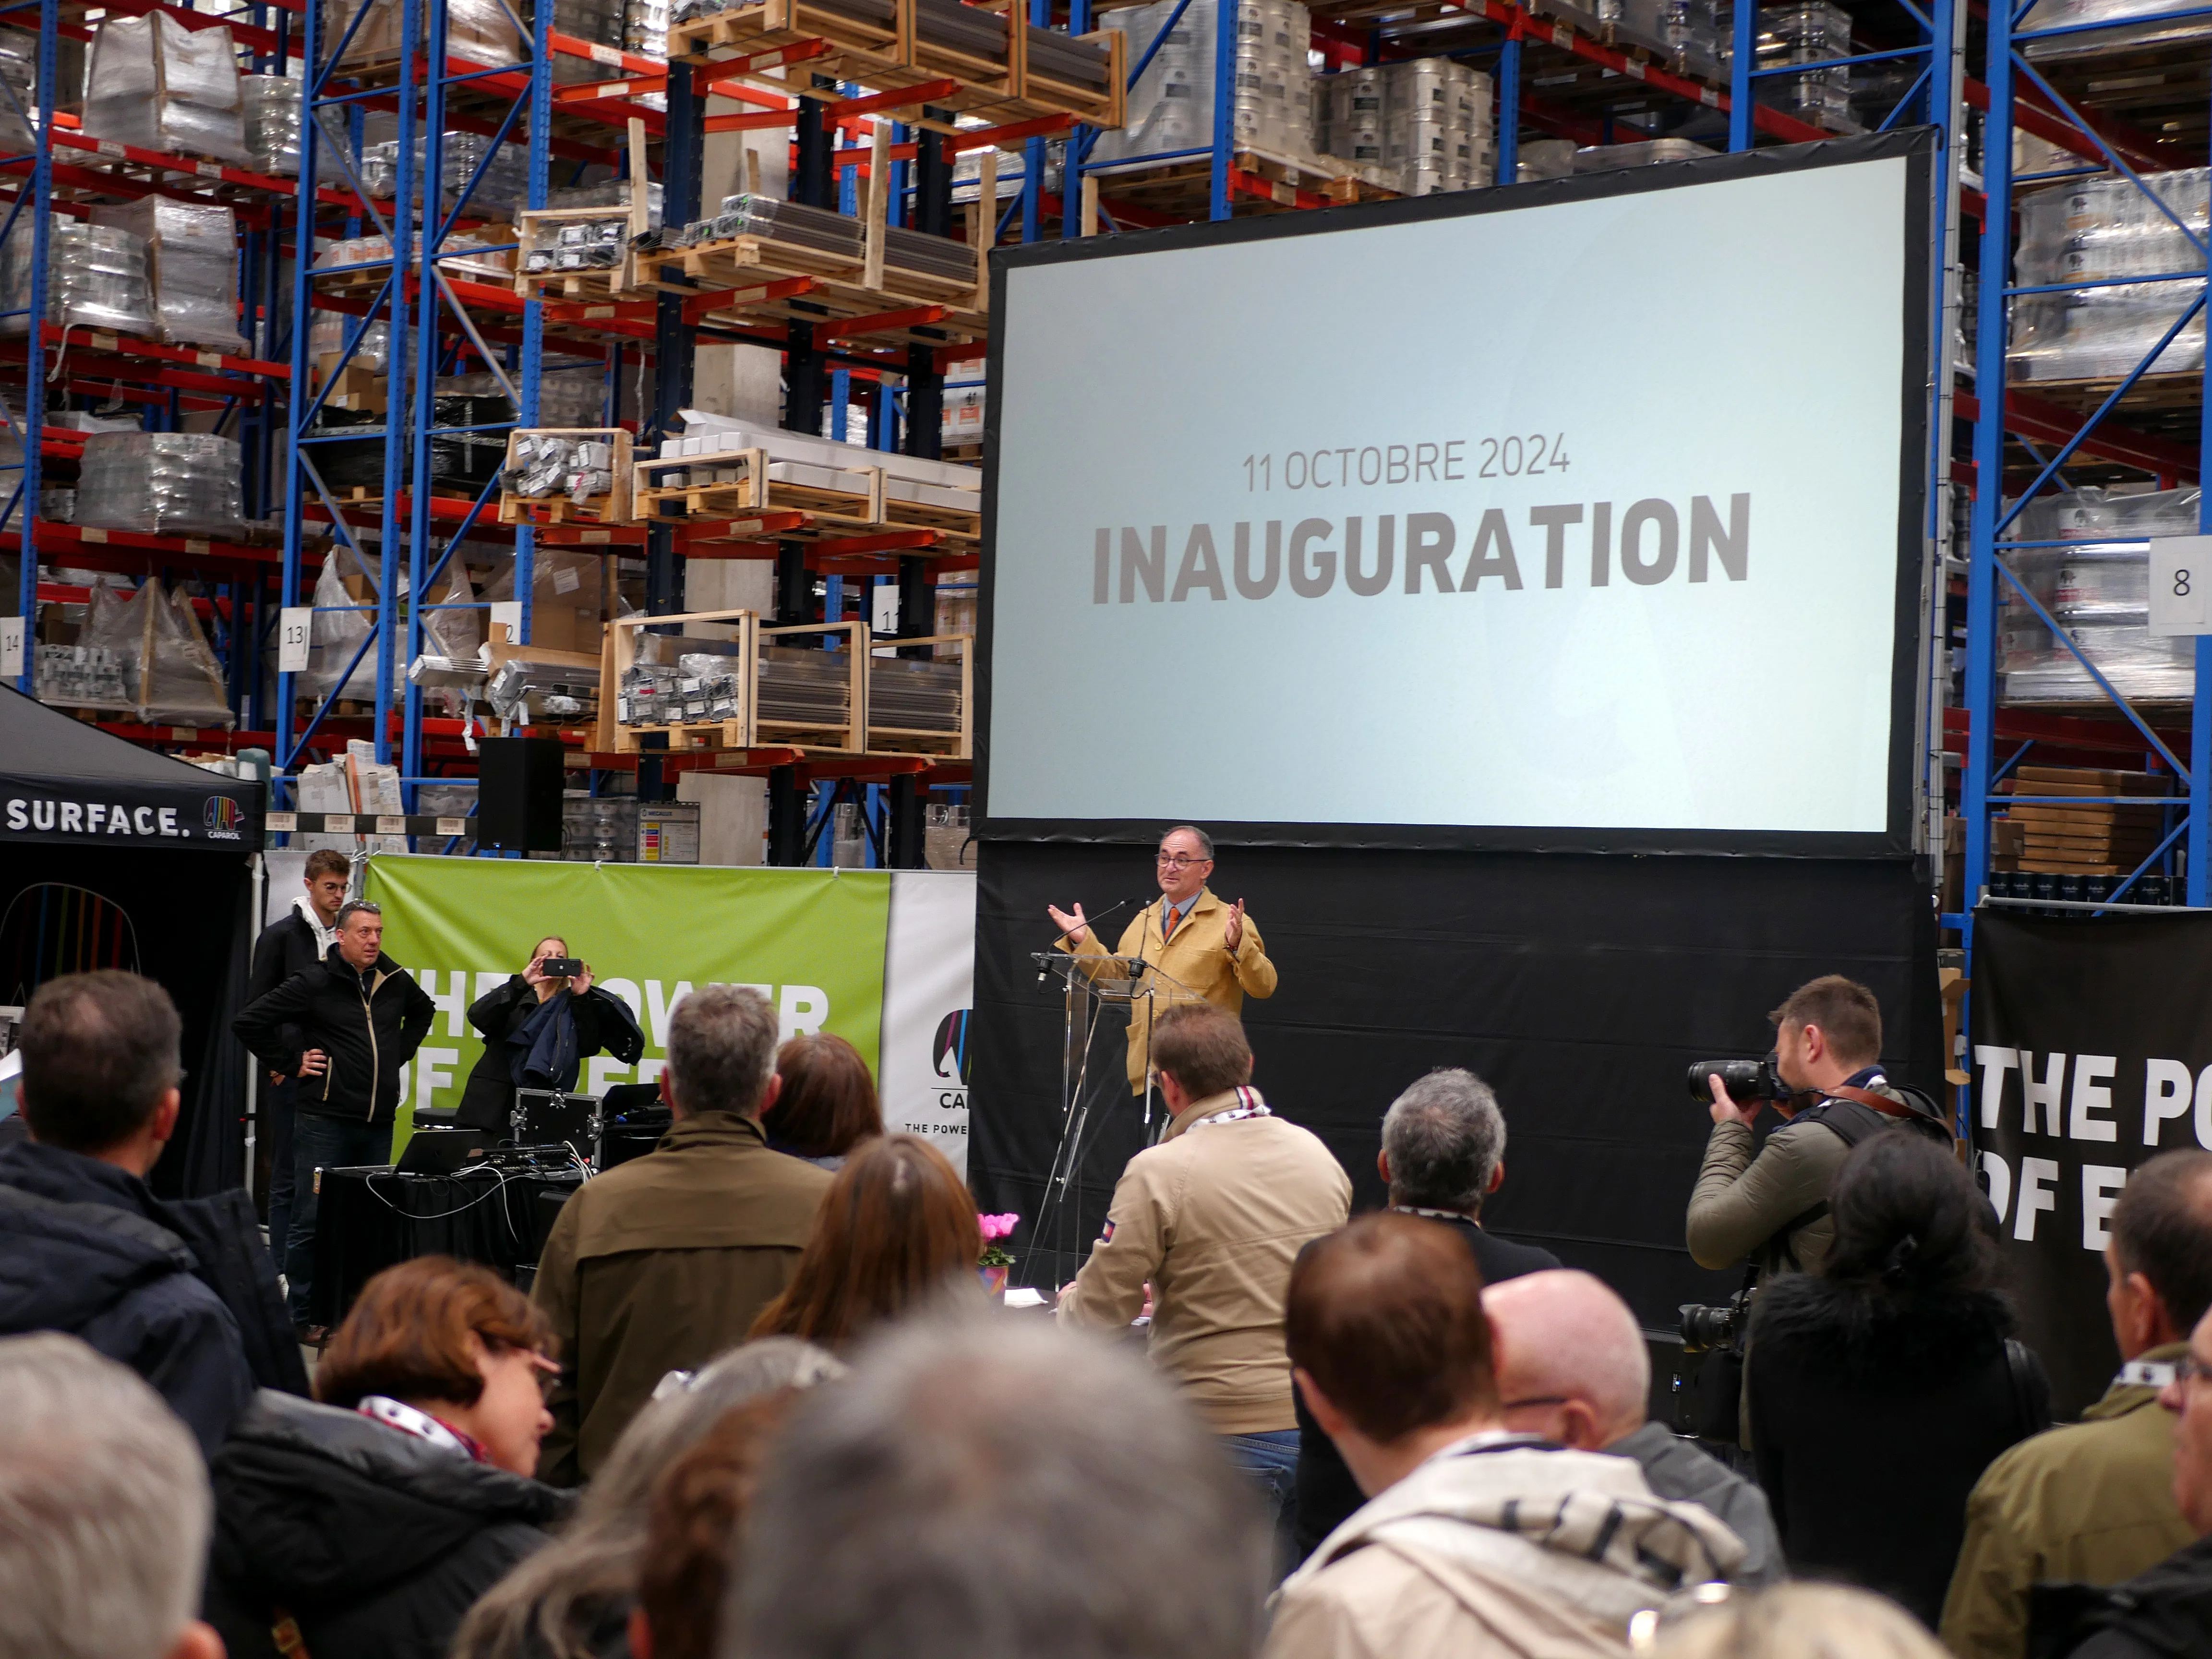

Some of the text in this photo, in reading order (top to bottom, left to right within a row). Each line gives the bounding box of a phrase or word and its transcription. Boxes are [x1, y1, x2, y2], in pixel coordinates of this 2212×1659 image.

[1243, 432, 1571, 492] 11 OCTOBRE 2024
[1093, 493, 1751, 605] INAUGURATION
[2174, 569, 2190, 596] 8
[6, 635, 19, 651] 14
[287, 626, 303, 644] 13
[6, 798, 191, 838] SURFACE.
[939, 1093, 970, 1110] CA
[1974, 1045, 2117, 1142] THE
[904, 1123, 928, 1133] THE
